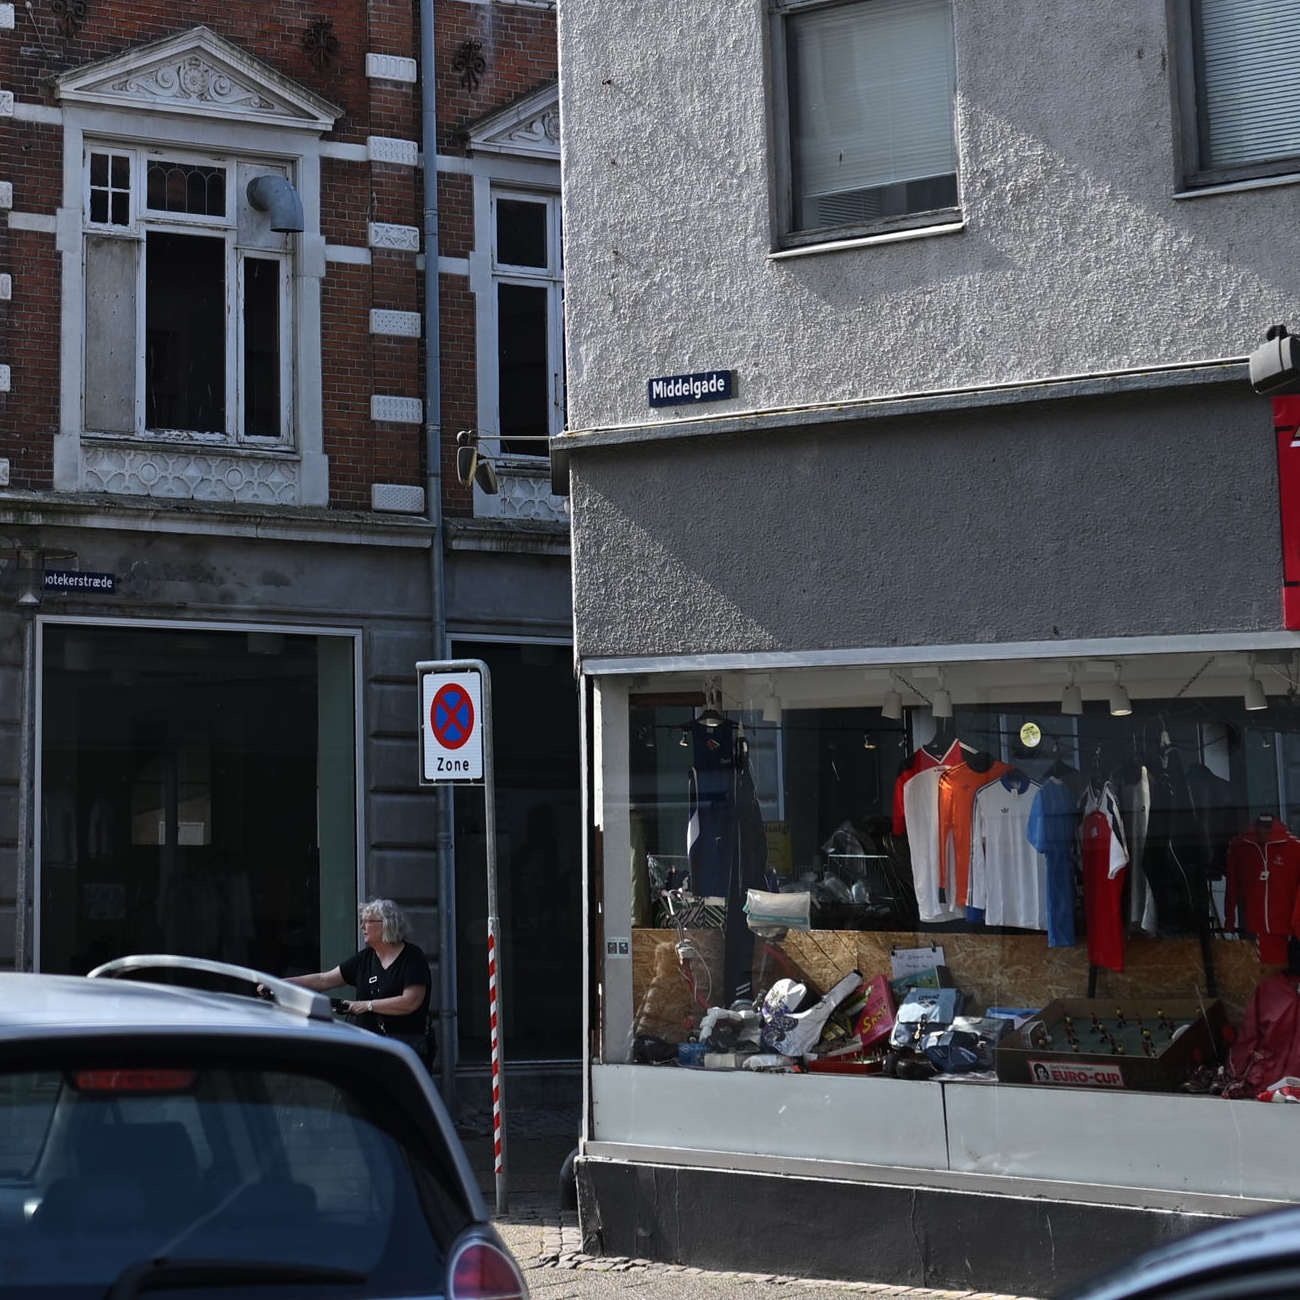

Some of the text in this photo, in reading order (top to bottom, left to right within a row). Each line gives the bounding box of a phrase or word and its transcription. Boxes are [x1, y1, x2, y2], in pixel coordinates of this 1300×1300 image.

[652, 374, 725, 399] Middelgade
[45, 573, 113, 588] otekerstræde
[437, 757, 469, 771] Zone
[1051, 1070, 1120, 1084] EURO-CUP
